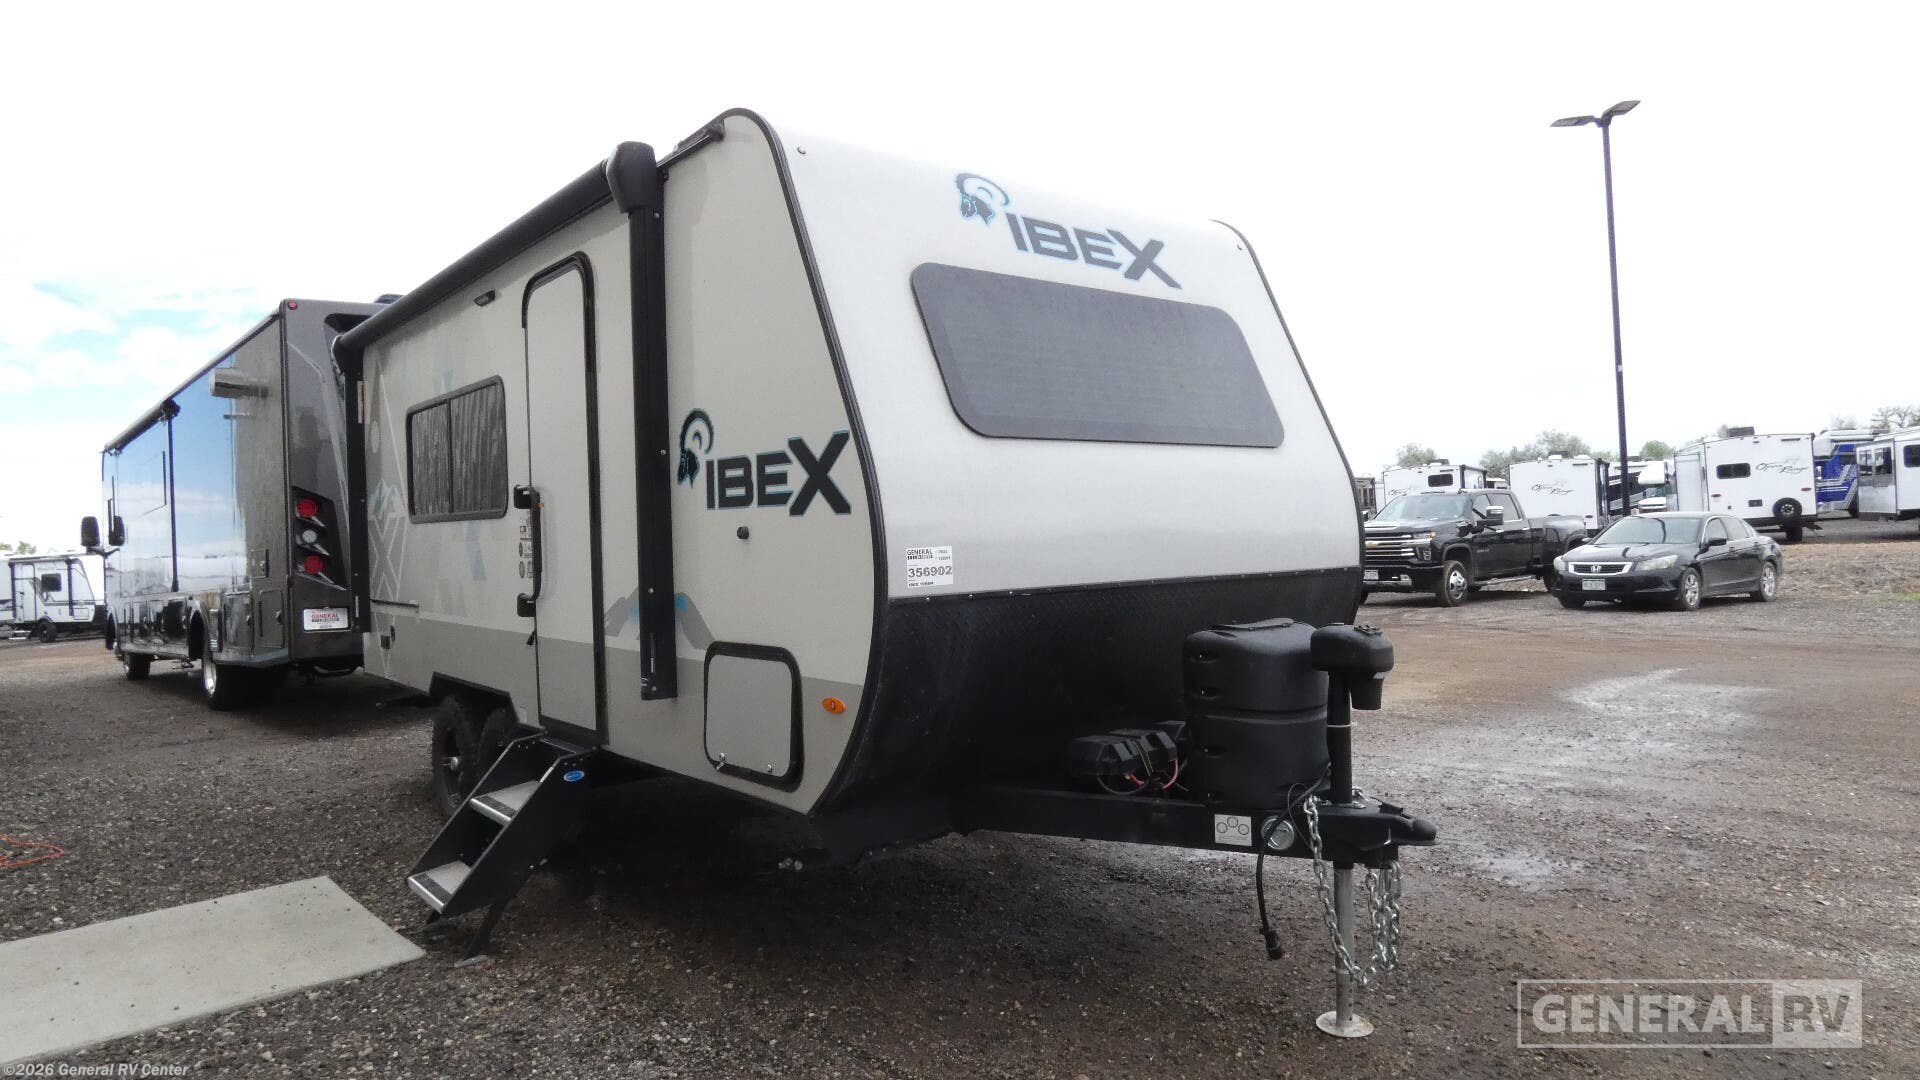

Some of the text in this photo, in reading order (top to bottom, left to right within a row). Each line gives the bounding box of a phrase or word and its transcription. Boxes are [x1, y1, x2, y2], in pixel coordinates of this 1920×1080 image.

[1005, 213, 1182, 289] IBEX
[706, 430, 851, 516] IBEX
[908, 566, 952, 577] 356902
